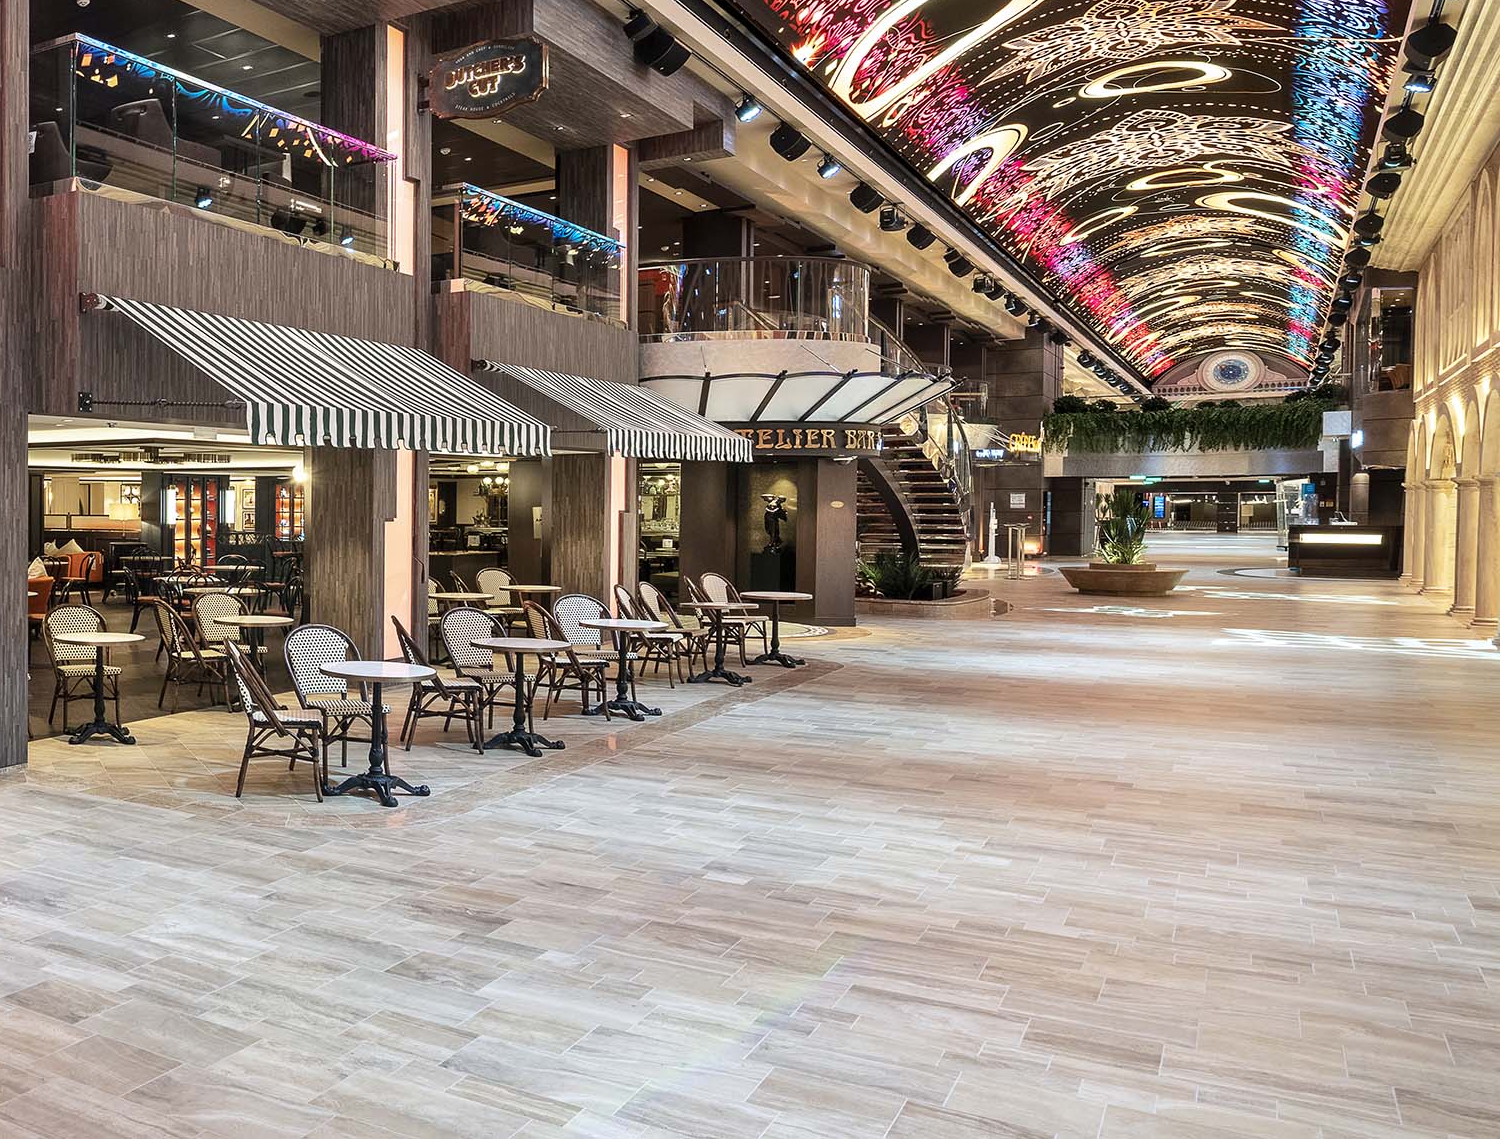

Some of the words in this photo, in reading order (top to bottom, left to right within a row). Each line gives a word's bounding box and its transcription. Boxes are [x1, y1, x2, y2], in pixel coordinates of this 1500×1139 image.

[468, 76, 500, 97] CUT
[733, 428, 837, 449] TELIER
[845, 428, 876, 450] BAR
